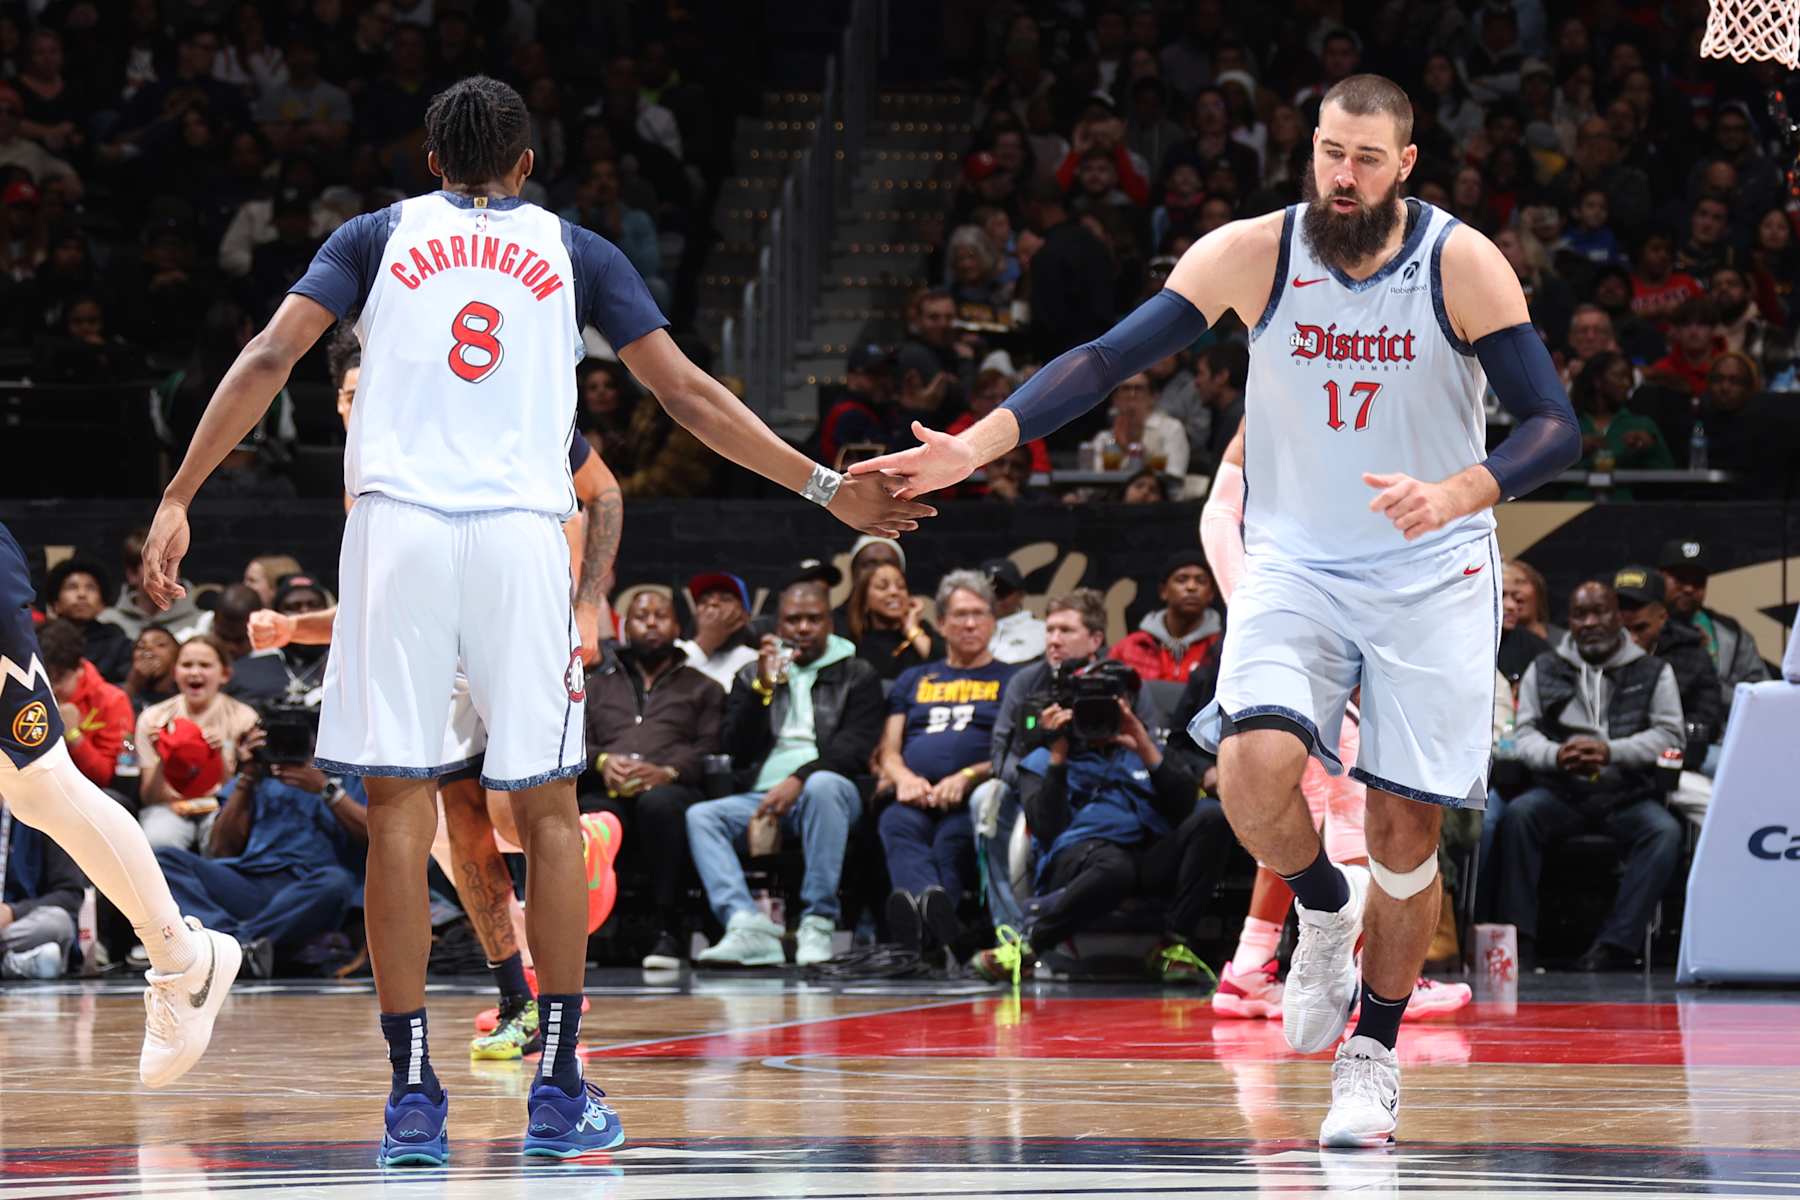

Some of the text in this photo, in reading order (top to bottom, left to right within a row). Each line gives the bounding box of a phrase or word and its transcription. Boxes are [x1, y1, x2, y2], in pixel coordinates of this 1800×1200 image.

[390, 234, 564, 302] CARRINGTON
[448, 300, 504, 384] 8
[1290, 321, 1416, 363] the District
[1326, 362, 1411, 372] COLUMBIA
[1323, 379, 1383, 432] 17
[915, 677, 1000, 703] DENVER
[926, 704, 975, 734] 27
